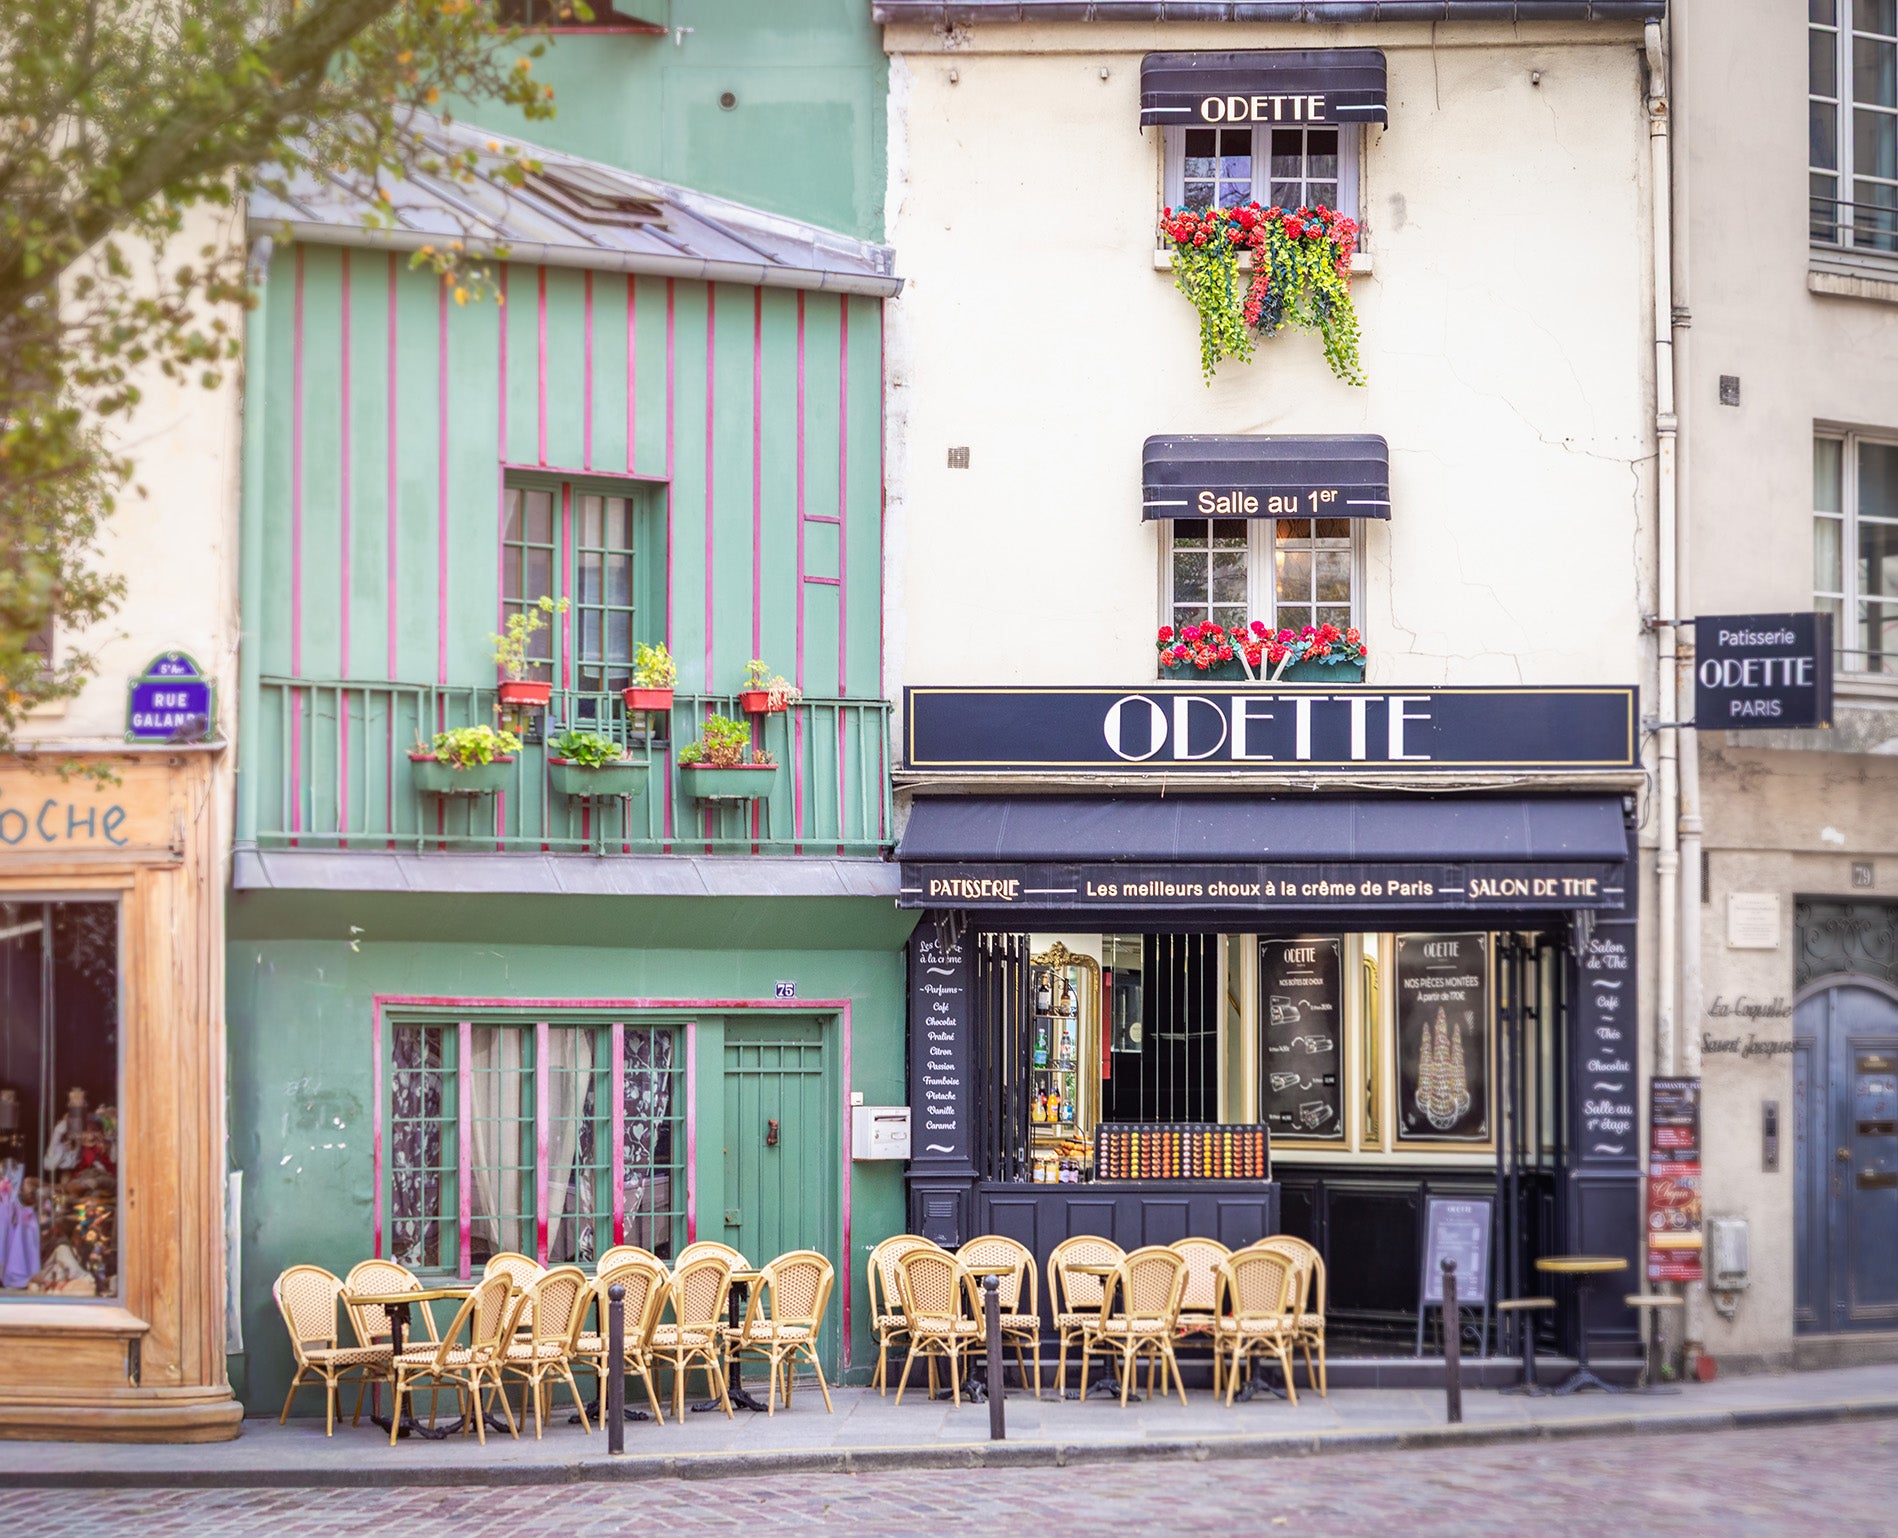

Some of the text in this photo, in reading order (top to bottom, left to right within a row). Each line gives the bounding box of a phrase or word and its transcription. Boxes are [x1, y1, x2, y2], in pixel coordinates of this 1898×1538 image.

[1200, 96, 1326, 122] ODETTE
[1198, 489, 1338, 514] Salle au 1er
[1718, 628, 1795, 646] Patisserie
[1700, 657, 1813, 688] ODETTE
[154, 693, 188, 708] RUE
[1731, 700, 1782, 716] PARIS
[133, 713, 196, 728] GALAN
[1103, 694, 1432, 762] ODETTE
[1855, 866, 1871, 886] 79
[929, 879, 1020, 900] PATISSERIE
[1087, 881, 1117, 897] Les
[1123, 881, 1202, 897] meilleurs
[1207, 881, 1261, 897] choux
[1265, 880, 1276, 897] à
[1281, 880, 1296, 896] la
[1360, 880, 1383, 896] de
[1388, 880, 1433, 897] Paris
[1469, 878, 1529, 898] SALON
[1533, 878, 1557, 897] DE
[920, 940, 933, 952] Les
[1424, 941, 1460, 957] ODETTE
[1590, 940, 1625, 954] Salon
[920, 953, 926, 963] à
[928, 952, 937, 963] la
[1284, 947, 1316, 963] ODETTE
[1587, 955, 1627, 969] de Thé
[1404, 975, 1479, 989] NOS PIÈCES MONTÉES
[776, 983, 794, 997] 75
[933, 1001, 949, 1014] Café
[1597, 996, 1619, 1011] Café
[925, 1017, 957, 1026] Chocolat
[927, 1031, 955, 1041] Praliné
[1596, 1027, 1621, 1040] Thés
[929, 1046, 953, 1056] Citron
[927, 1061, 955, 1071] Passion
[1588, 1060, 1630, 1071] Chocolat
[925, 1091, 956, 1101] Pistache
[927, 1106, 955, 1115] Vanille
[1584, 1101, 1633, 1115] Salle au
[926, 1121, 956, 1130] Caramel
[1601, 1119, 1631, 1134] étage
[1652, 1181, 1689, 1205] Chopin
